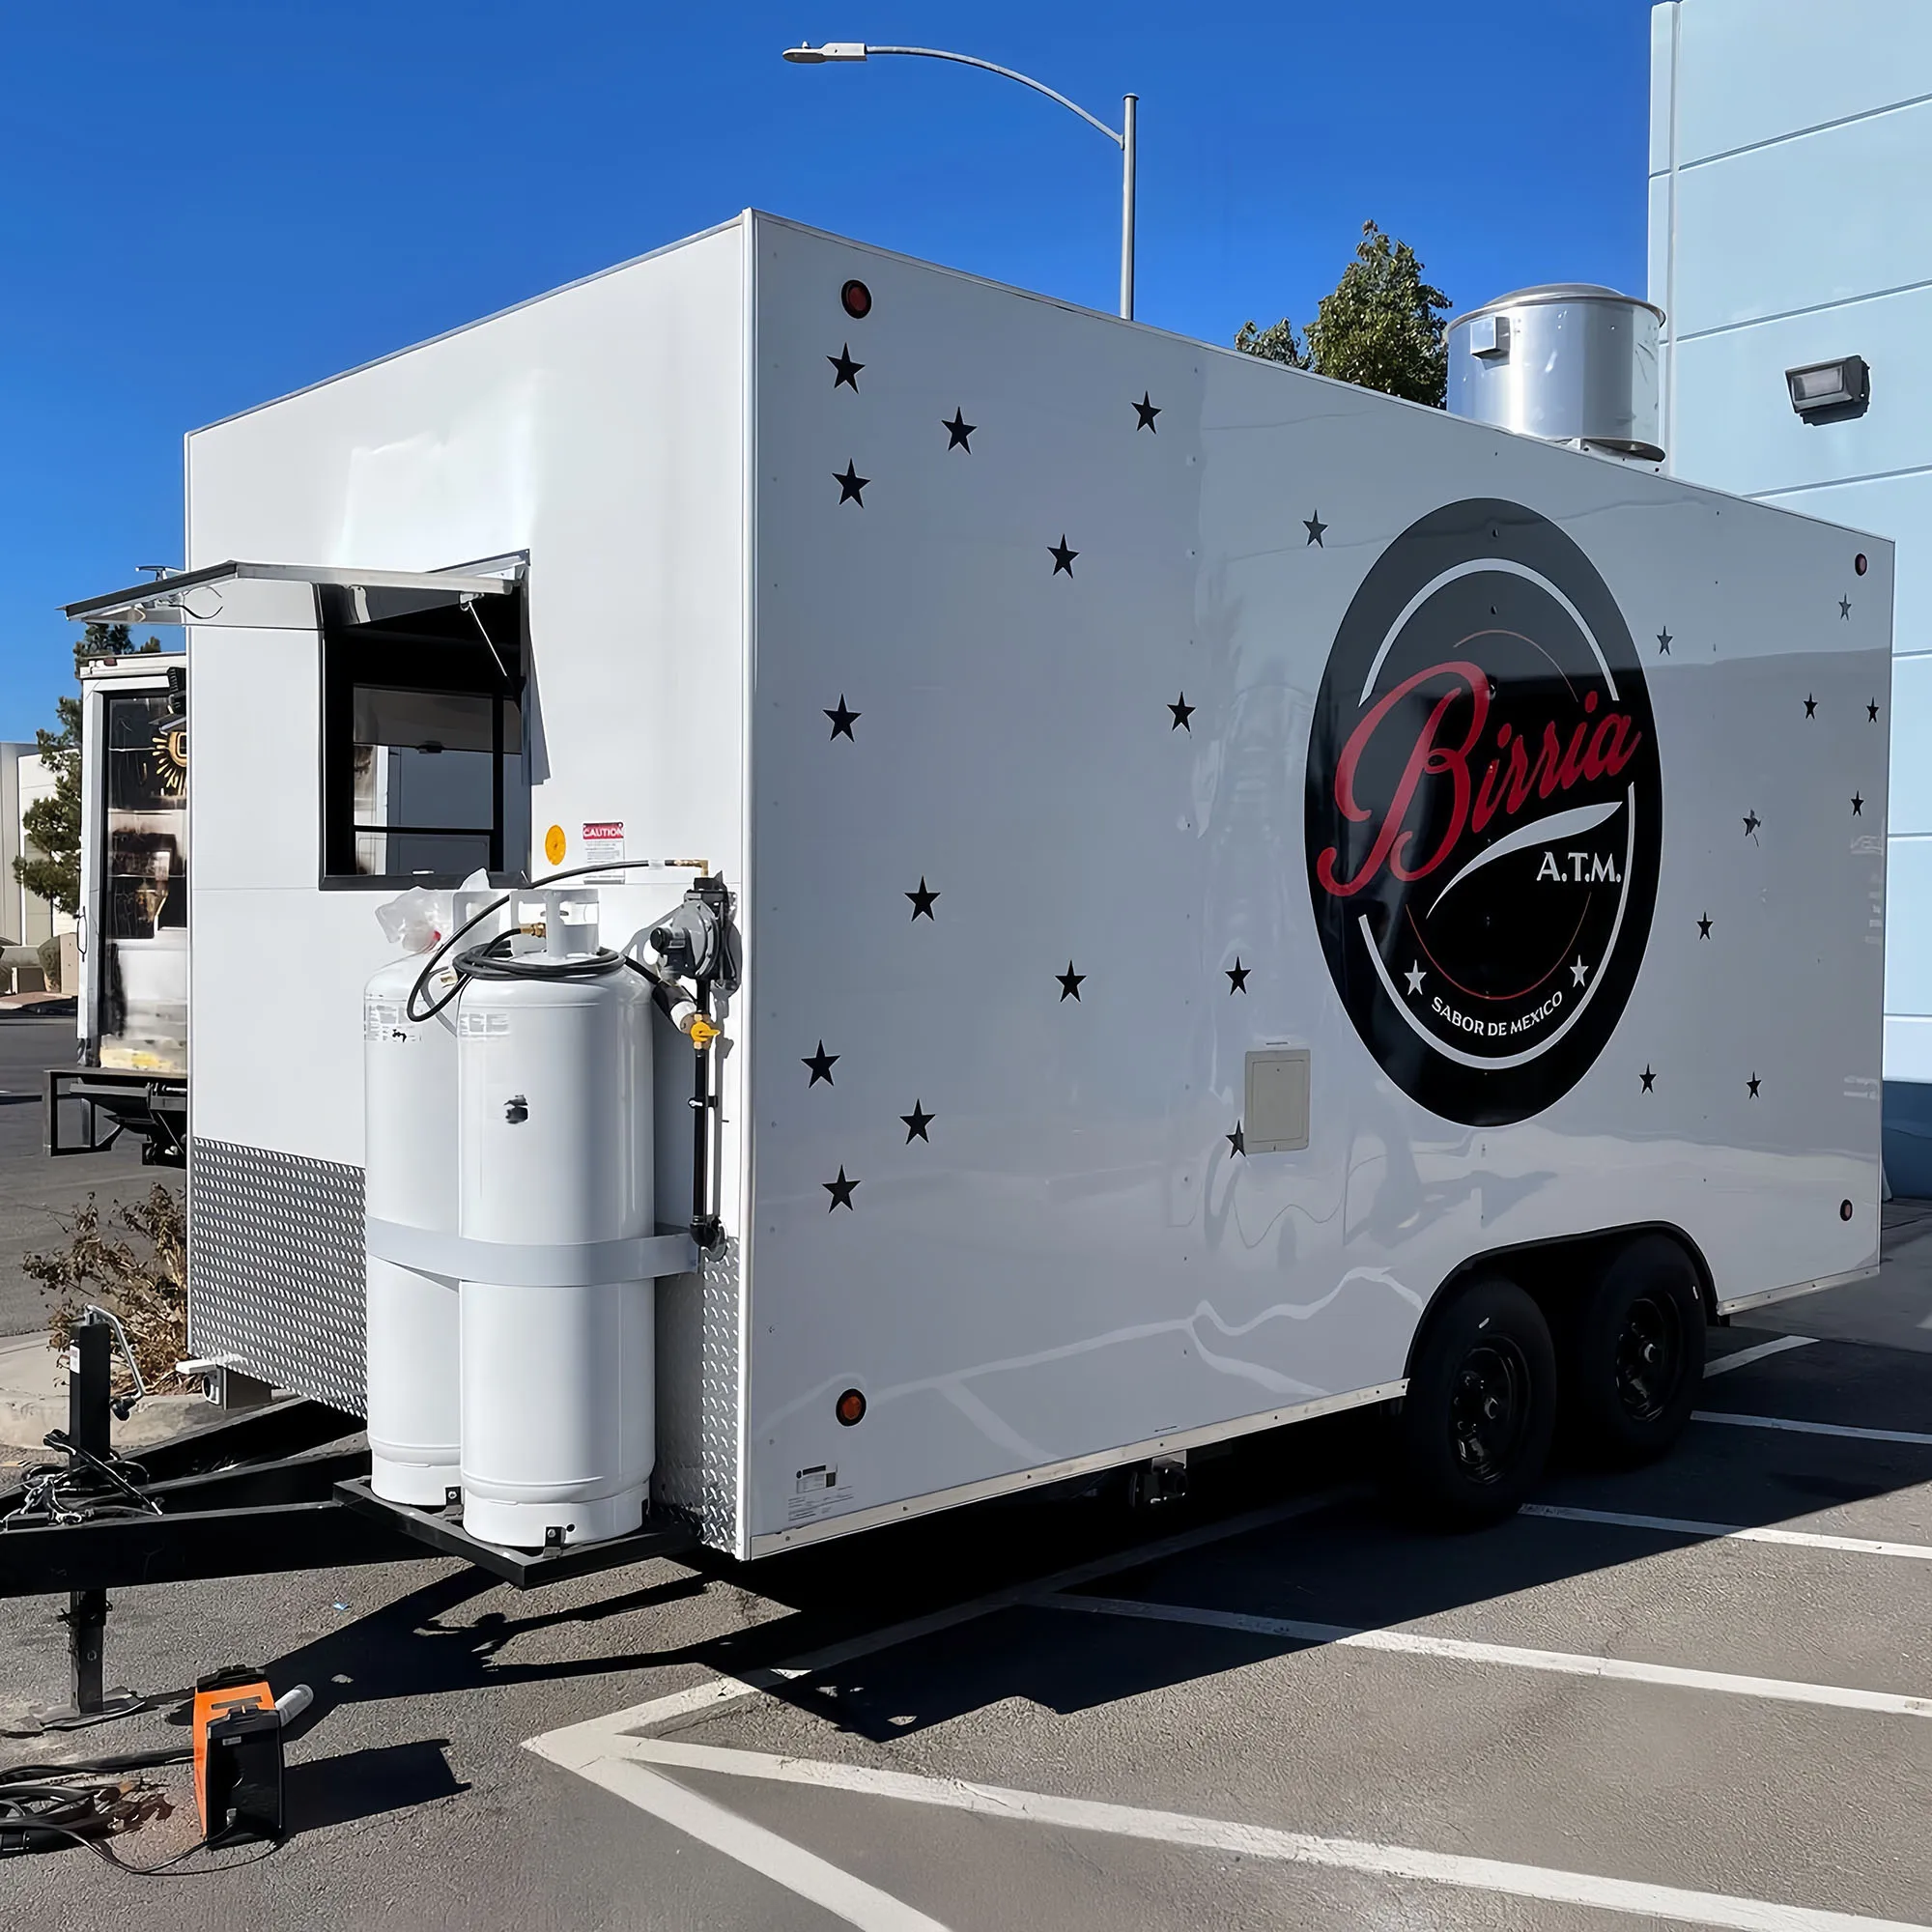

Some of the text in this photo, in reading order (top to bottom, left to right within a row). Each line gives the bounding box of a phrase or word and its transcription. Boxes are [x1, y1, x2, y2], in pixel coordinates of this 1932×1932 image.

[1317, 661, 1641, 896] Birria
[583, 826, 624, 838] CAUTION
[1536, 851, 1622, 883] A.T.M.
[1431, 990, 1563, 1037] SABOR DE MEXICO
